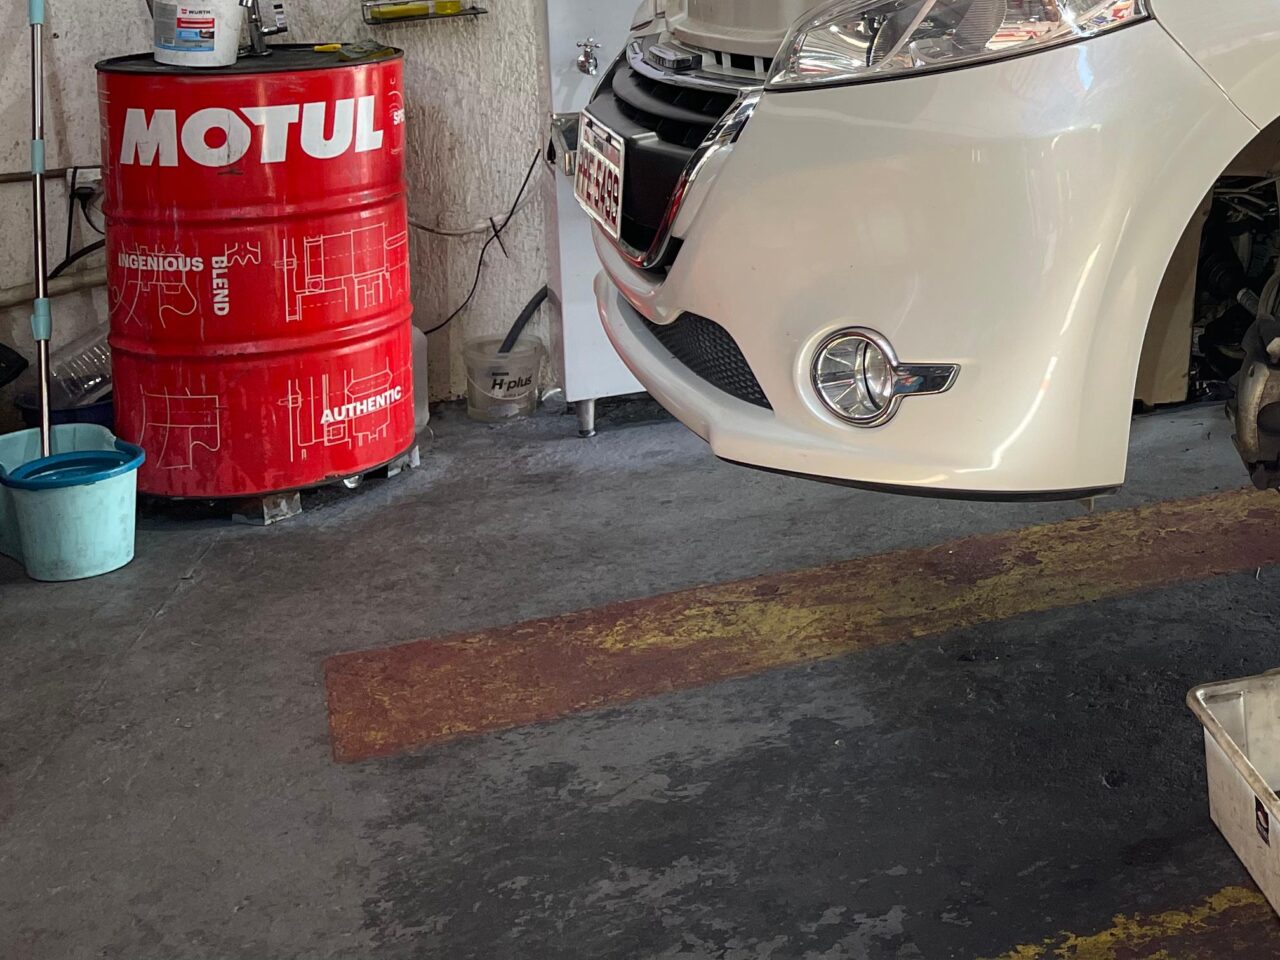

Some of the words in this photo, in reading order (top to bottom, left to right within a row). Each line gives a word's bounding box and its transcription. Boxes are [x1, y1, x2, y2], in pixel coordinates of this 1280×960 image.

[120, 95, 384, 167] MOTUL
[117, 251, 204, 273] INGENIOUS
[211, 255, 229, 316] BLEND
[320, 385, 403, 424] AUTHENTIC
